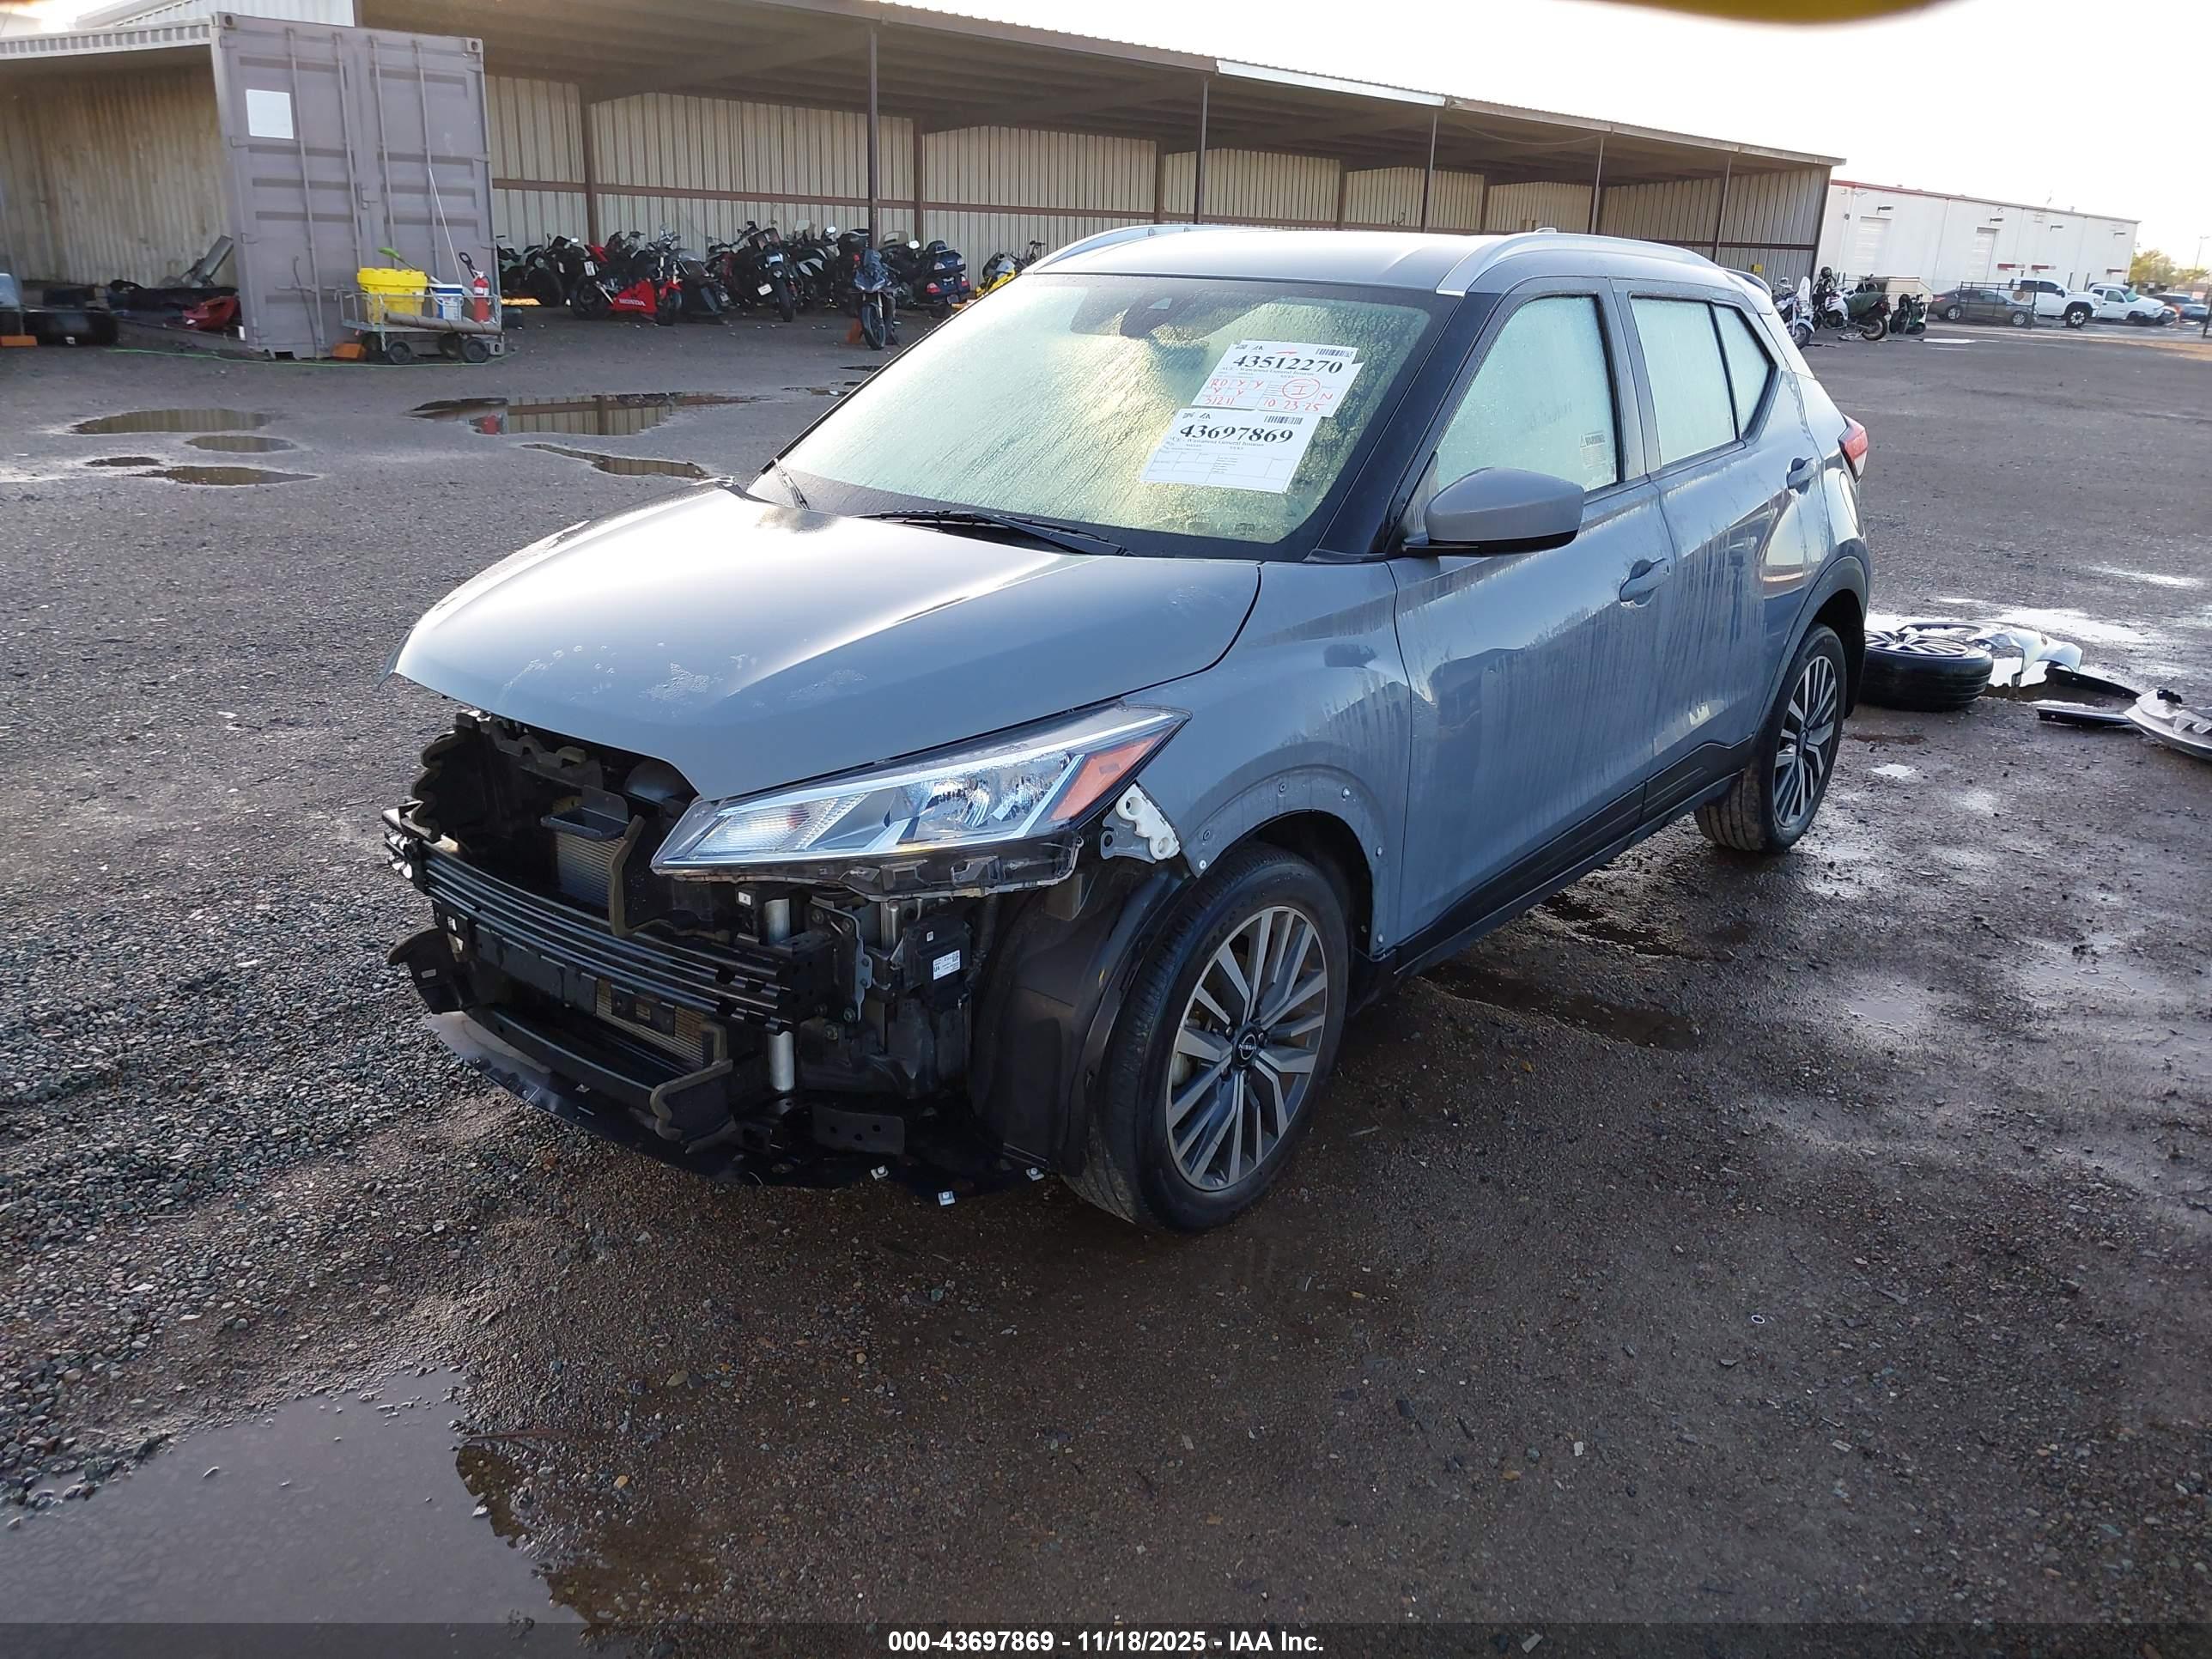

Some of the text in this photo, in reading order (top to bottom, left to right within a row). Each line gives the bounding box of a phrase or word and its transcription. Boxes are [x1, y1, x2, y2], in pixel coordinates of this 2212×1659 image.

[1233, 355, 1343, 374] 43512270
[1284, 401, 1298, 410] 23
[1304, 403, 1325, 412] 25
[1180, 424, 1293, 443] 43697869
